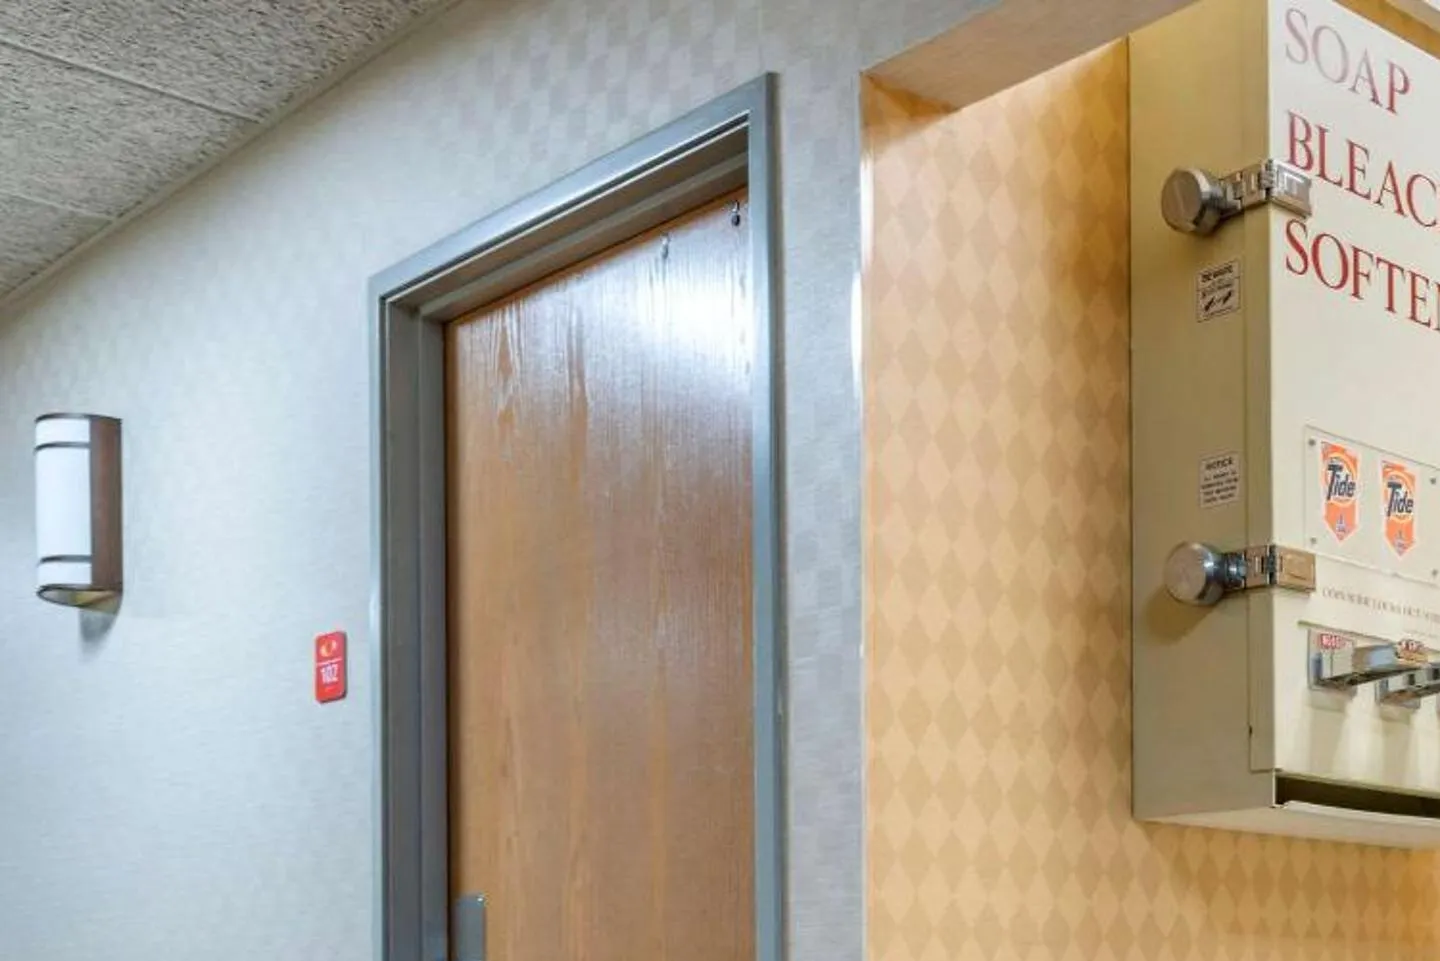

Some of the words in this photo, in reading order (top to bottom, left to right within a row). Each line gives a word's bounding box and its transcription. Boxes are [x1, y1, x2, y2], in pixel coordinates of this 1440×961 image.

[1284, 7, 1411, 115] SOAP
[1326, 463, 1356, 501] Tide
[1386, 480, 1414, 518] Tide
